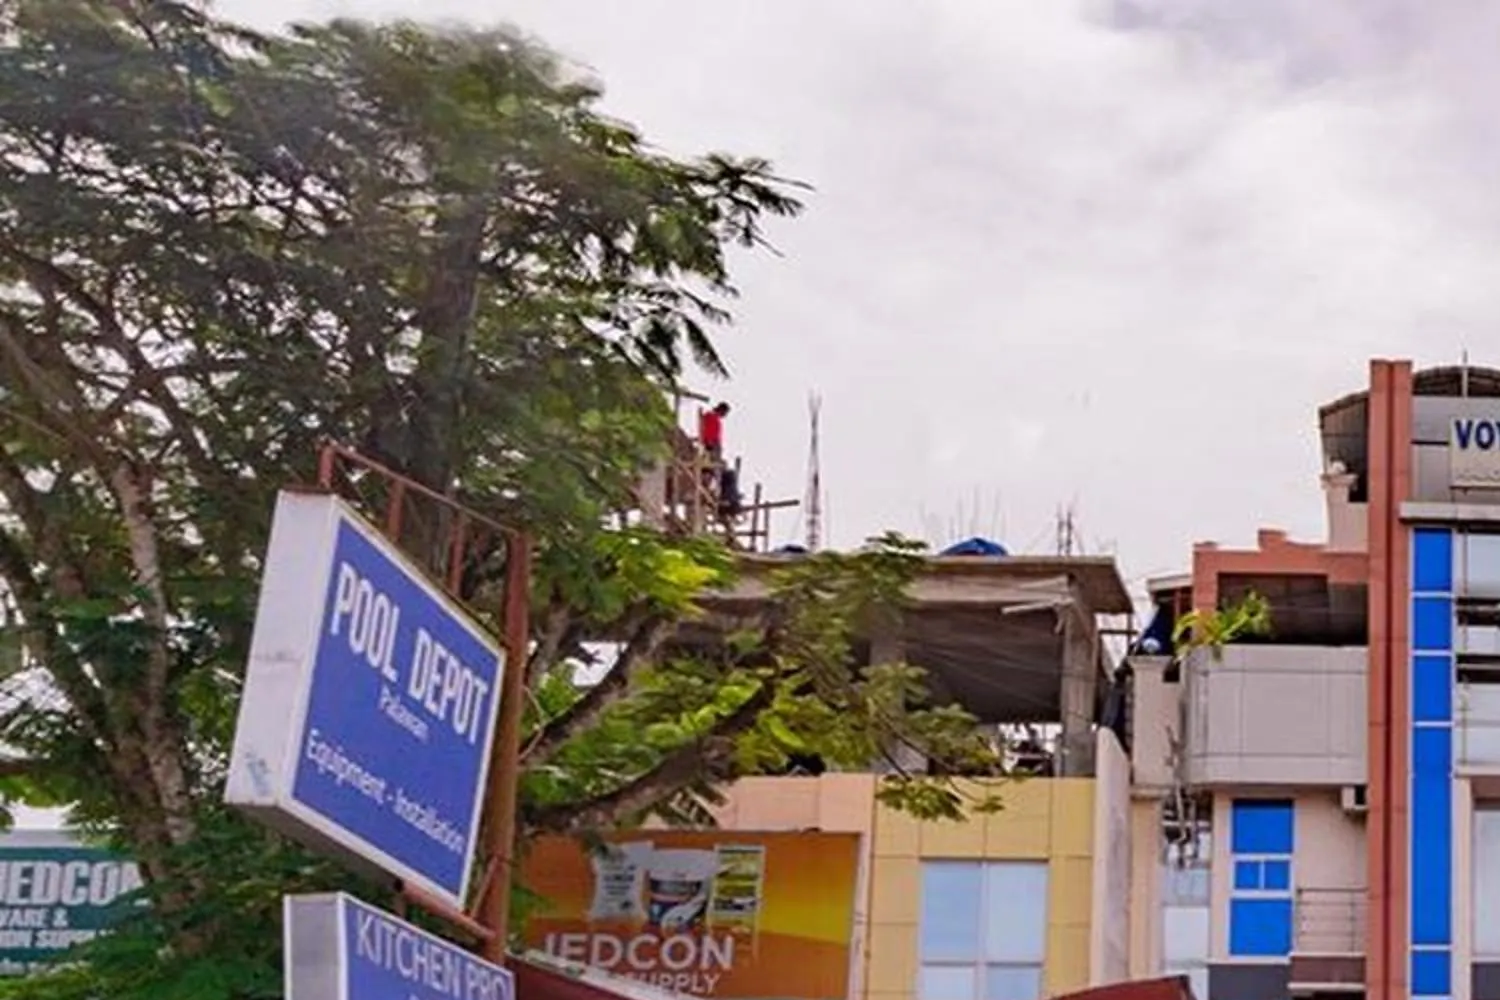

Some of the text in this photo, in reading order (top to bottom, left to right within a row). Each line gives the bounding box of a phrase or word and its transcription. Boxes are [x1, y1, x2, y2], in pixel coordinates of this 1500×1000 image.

[330, 559, 489, 746] POOL DEPOT
[306, 727, 386, 804] Equipment
[356, 908, 461, 1000] KITCHEN
